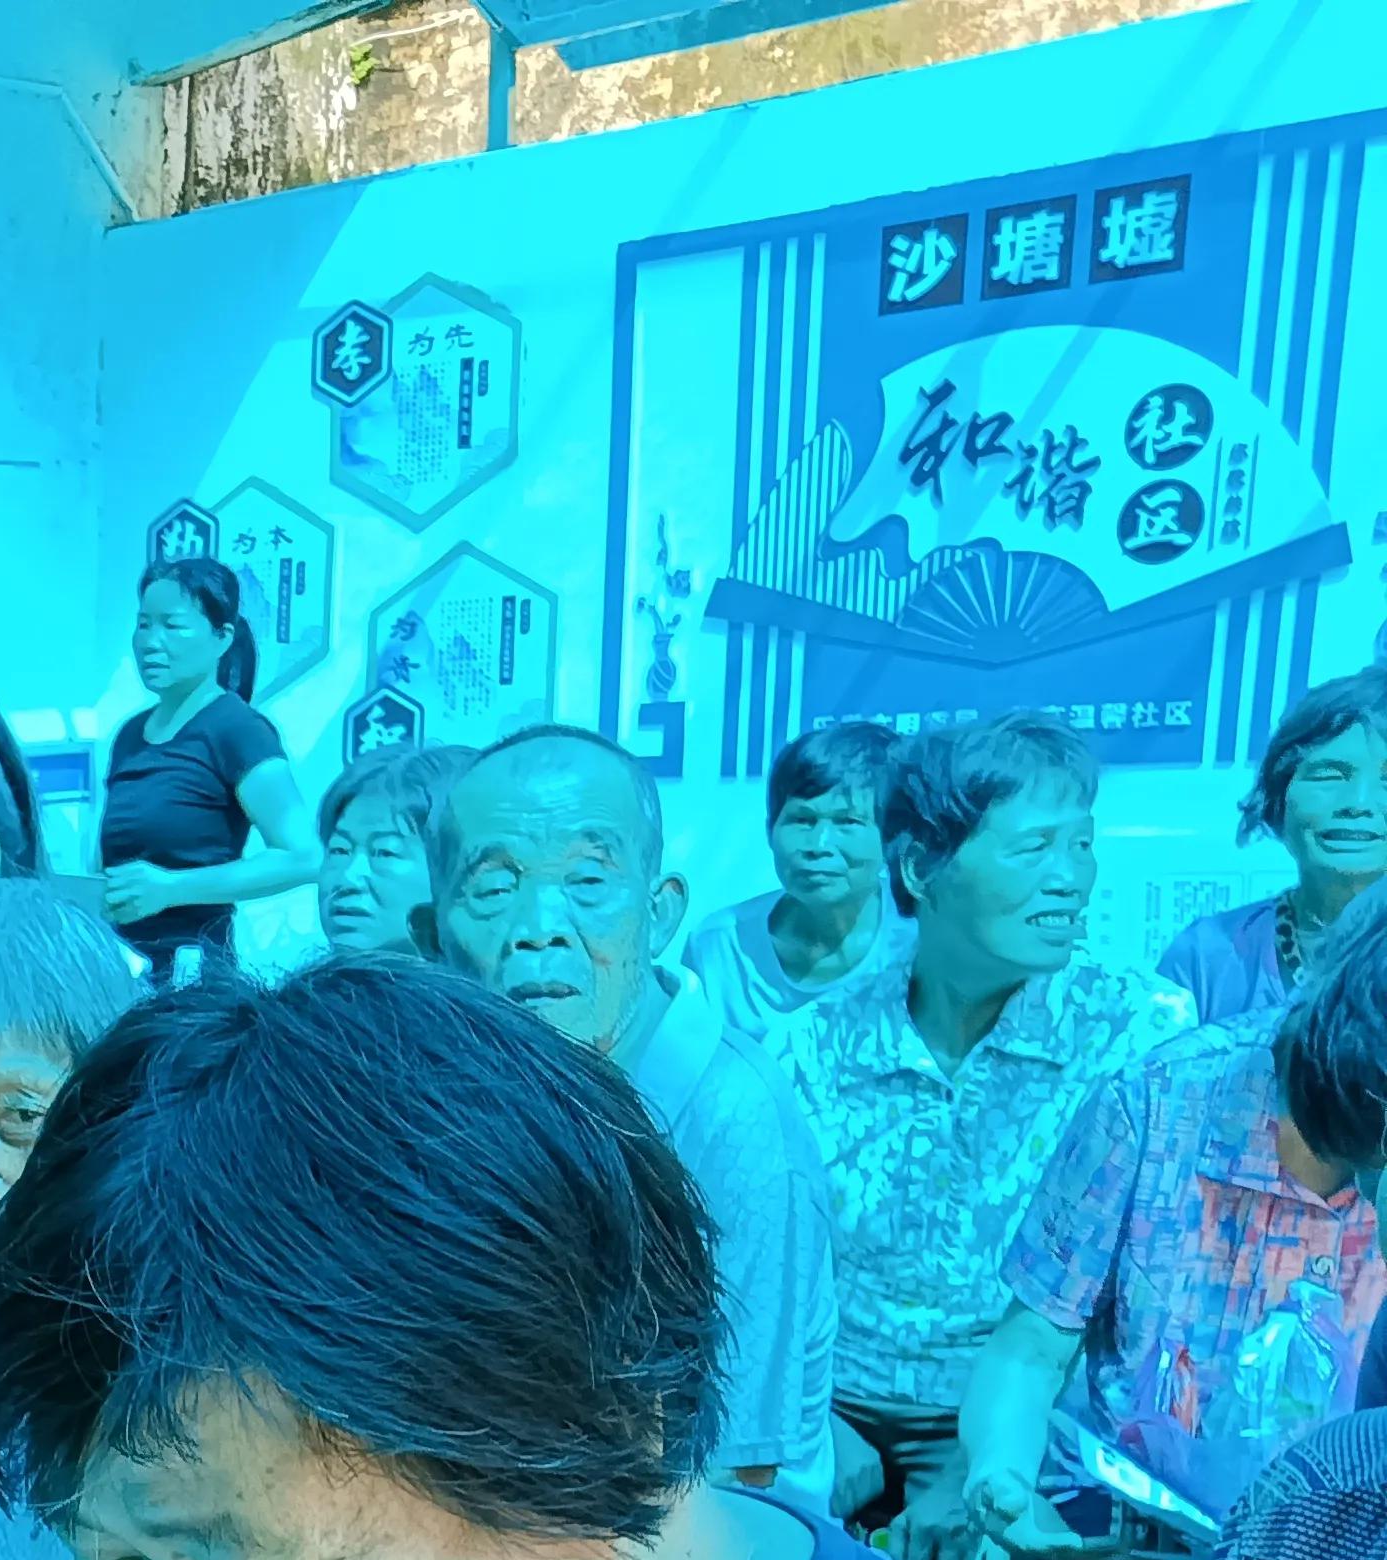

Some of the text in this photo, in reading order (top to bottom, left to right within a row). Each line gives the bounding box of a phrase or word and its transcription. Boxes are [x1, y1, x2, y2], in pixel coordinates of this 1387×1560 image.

[887, 188, 1180, 303] 沙塘墟
[899, 378, 1102, 533] 和谐
[1123, 395, 1204, 550] 社区
